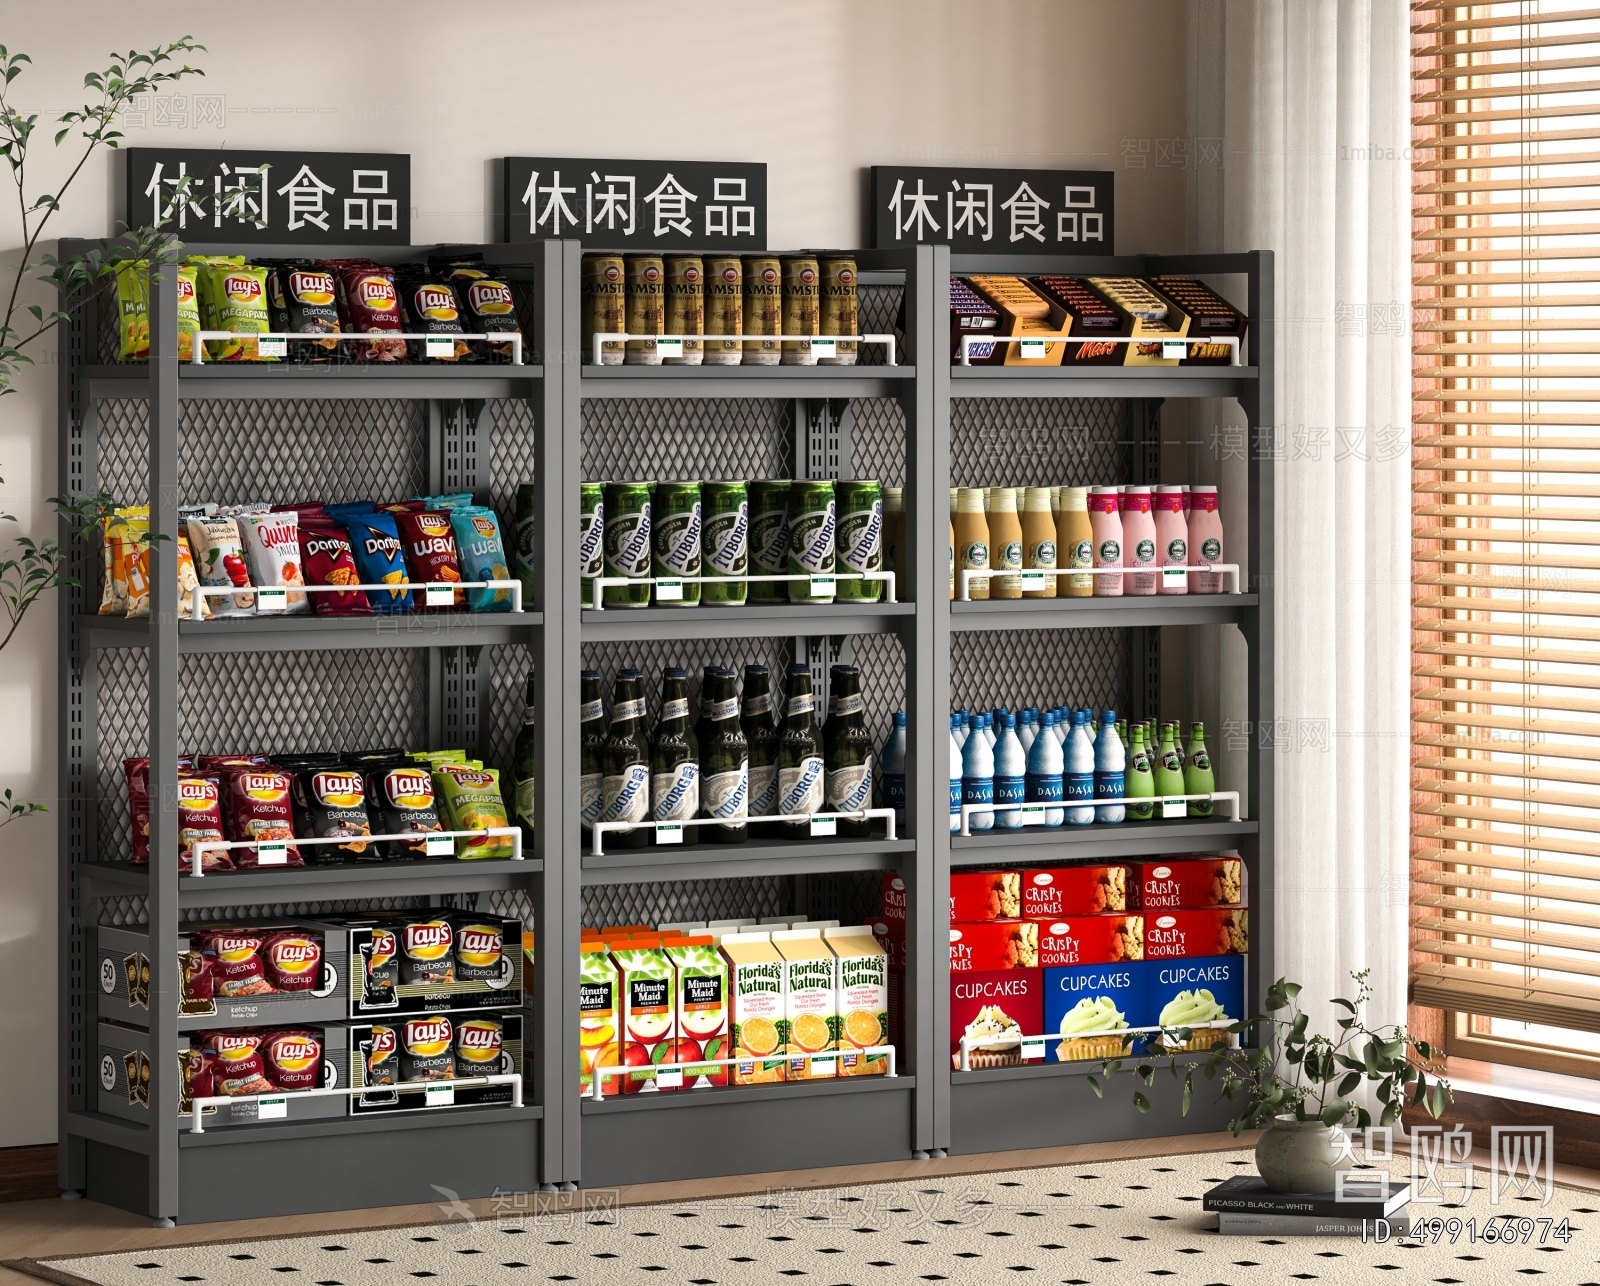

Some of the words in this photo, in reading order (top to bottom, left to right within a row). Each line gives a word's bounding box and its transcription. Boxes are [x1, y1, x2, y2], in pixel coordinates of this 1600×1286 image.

[144, 161, 399, 232] 休闲食品
[521, 169, 756, 238] 休闲食品
[887, 178, 1105, 244] 休闲食品
[371, 313, 399, 324] Ketchup
[607, 520, 631, 550] COPENHAGEN
[712, 517, 748, 569] TUBORG
[801, 515, 835, 568] TUBORG
[846, 514, 882, 567] TUBORG
[413, 536, 457, 556] wav
[471, 538, 501, 556] wav
[614, 517, 651, 571] TUBORG
[665, 517, 701, 570] TUBORG
[603, 780, 641, 822] TUBORG
[779, 772, 818, 815] TUBORG
[253, 804, 287, 815] Ketchup
[185, 813, 218, 824] Ketchup
[1025, 887, 1063, 903] CRISPY
[1144, 880, 1180, 895] CRISPY
[1025, 902, 1063, 915] COOKIES
[1144, 894, 1181, 907] COOKIES
[1041, 936, 1079, 952] CRISPY
[1147, 929, 1186, 944] CRISPY
[1041, 951, 1079, 964] COOKIES
[1147, 943, 1186, 956] COOKIES
[103, 963, 113, 979] 50
[225, 961, 257, 976] Ketchup
[738, 963, 781, 982] Florida's
[789, 960, 832, 979] Florida's
[842, 957, 884, 975] Florida's
[279, 976, 313, 984] Ketchup
[842, 971, 883, 990] Natural
[1060, 972, 1131, 992] CUPCAKES
[1159, 965, 1230, 985] CUPCAKES
[634, 983, 665, 993] Minute
[687, 979, 718, 989] Minute
[738, 978, 781, 997] Natural
[789, 975, 832, 993] Natural
[955, 979, 1028, 1000] CUPCAKES
[638, 992, 661, 1002] Maid
[691, 988, 715, 998] Maid
[103, 1061, 113, 1077] 50
[225, 1059, 257, 1074] Ketchup
[279, 1074, 313, 1082] Ketchup
[1208, 1199, 1246, 1208] PICASSO
[1247, 1201, 1275, 1210] BLACK
[1285, 1202, 1314, 1211] WHITE
[1315, 1224, 1346, 1233] JASPER
